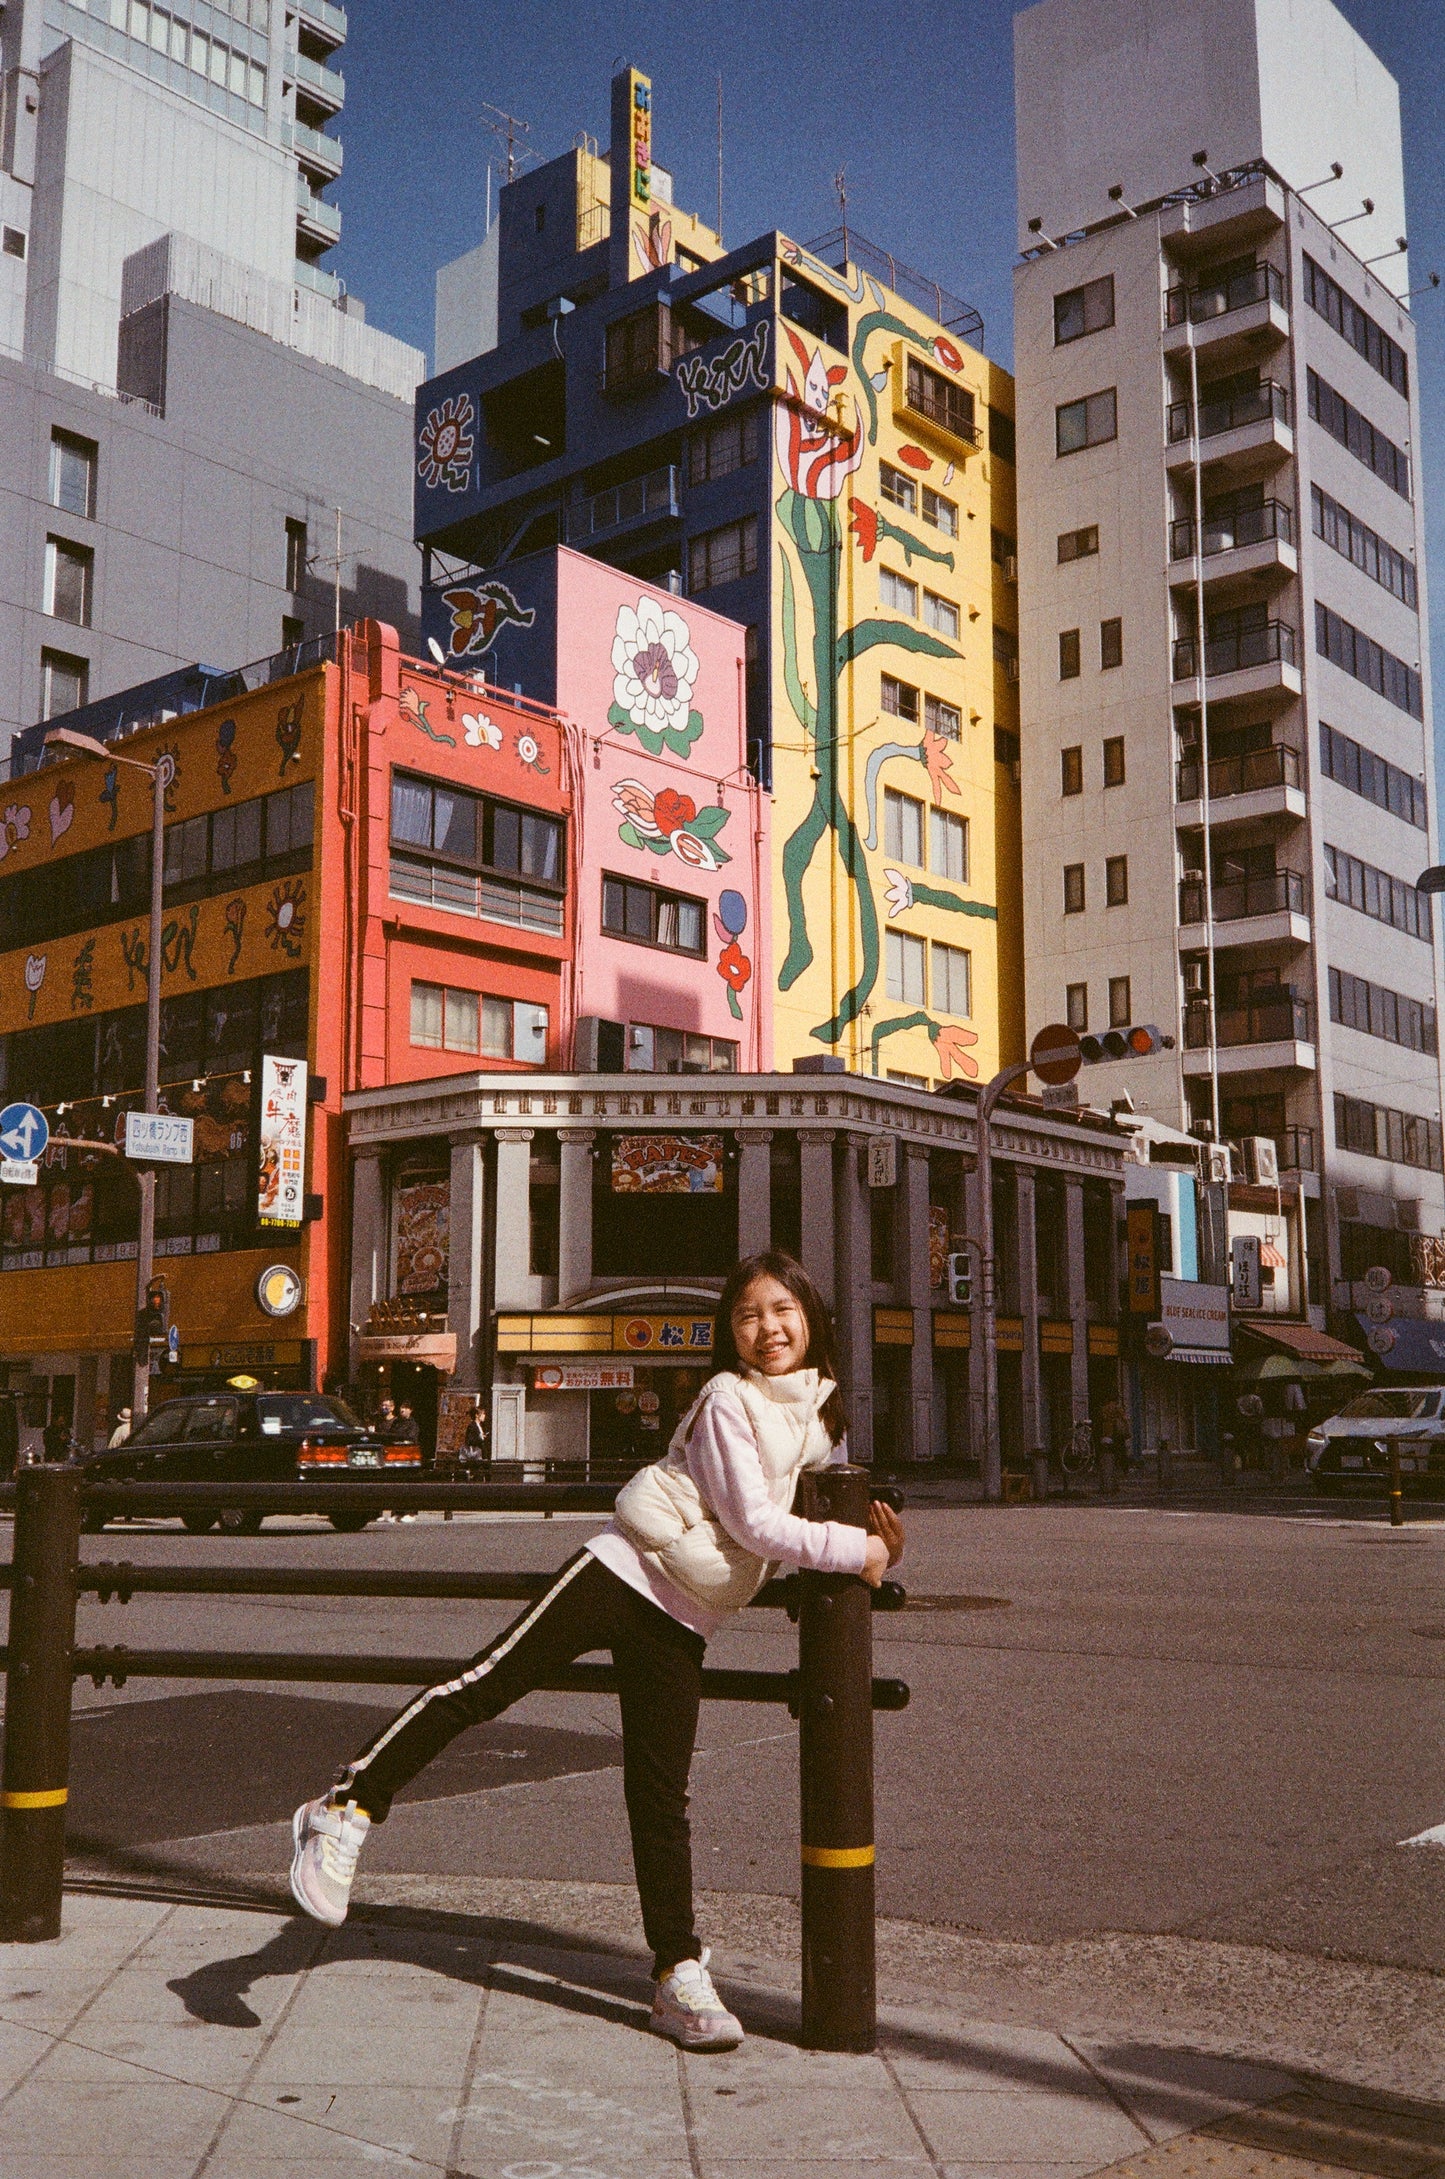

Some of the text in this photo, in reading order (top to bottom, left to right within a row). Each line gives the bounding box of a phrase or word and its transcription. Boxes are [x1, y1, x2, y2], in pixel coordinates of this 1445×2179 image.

[635, 82, 651, 200] おおきに
[132, 1119, 188, 1142] 四ツ橋ランプ西
[1166, 1305, 1180, 1317] BLUE
[1182, 1306, 1195, 1319] SEAL
[1207, 1309, 1227, 1321] CREAM
[658, 1321, 713, 1347] 松屋
[600, 1371, 631, 1387] 無料
